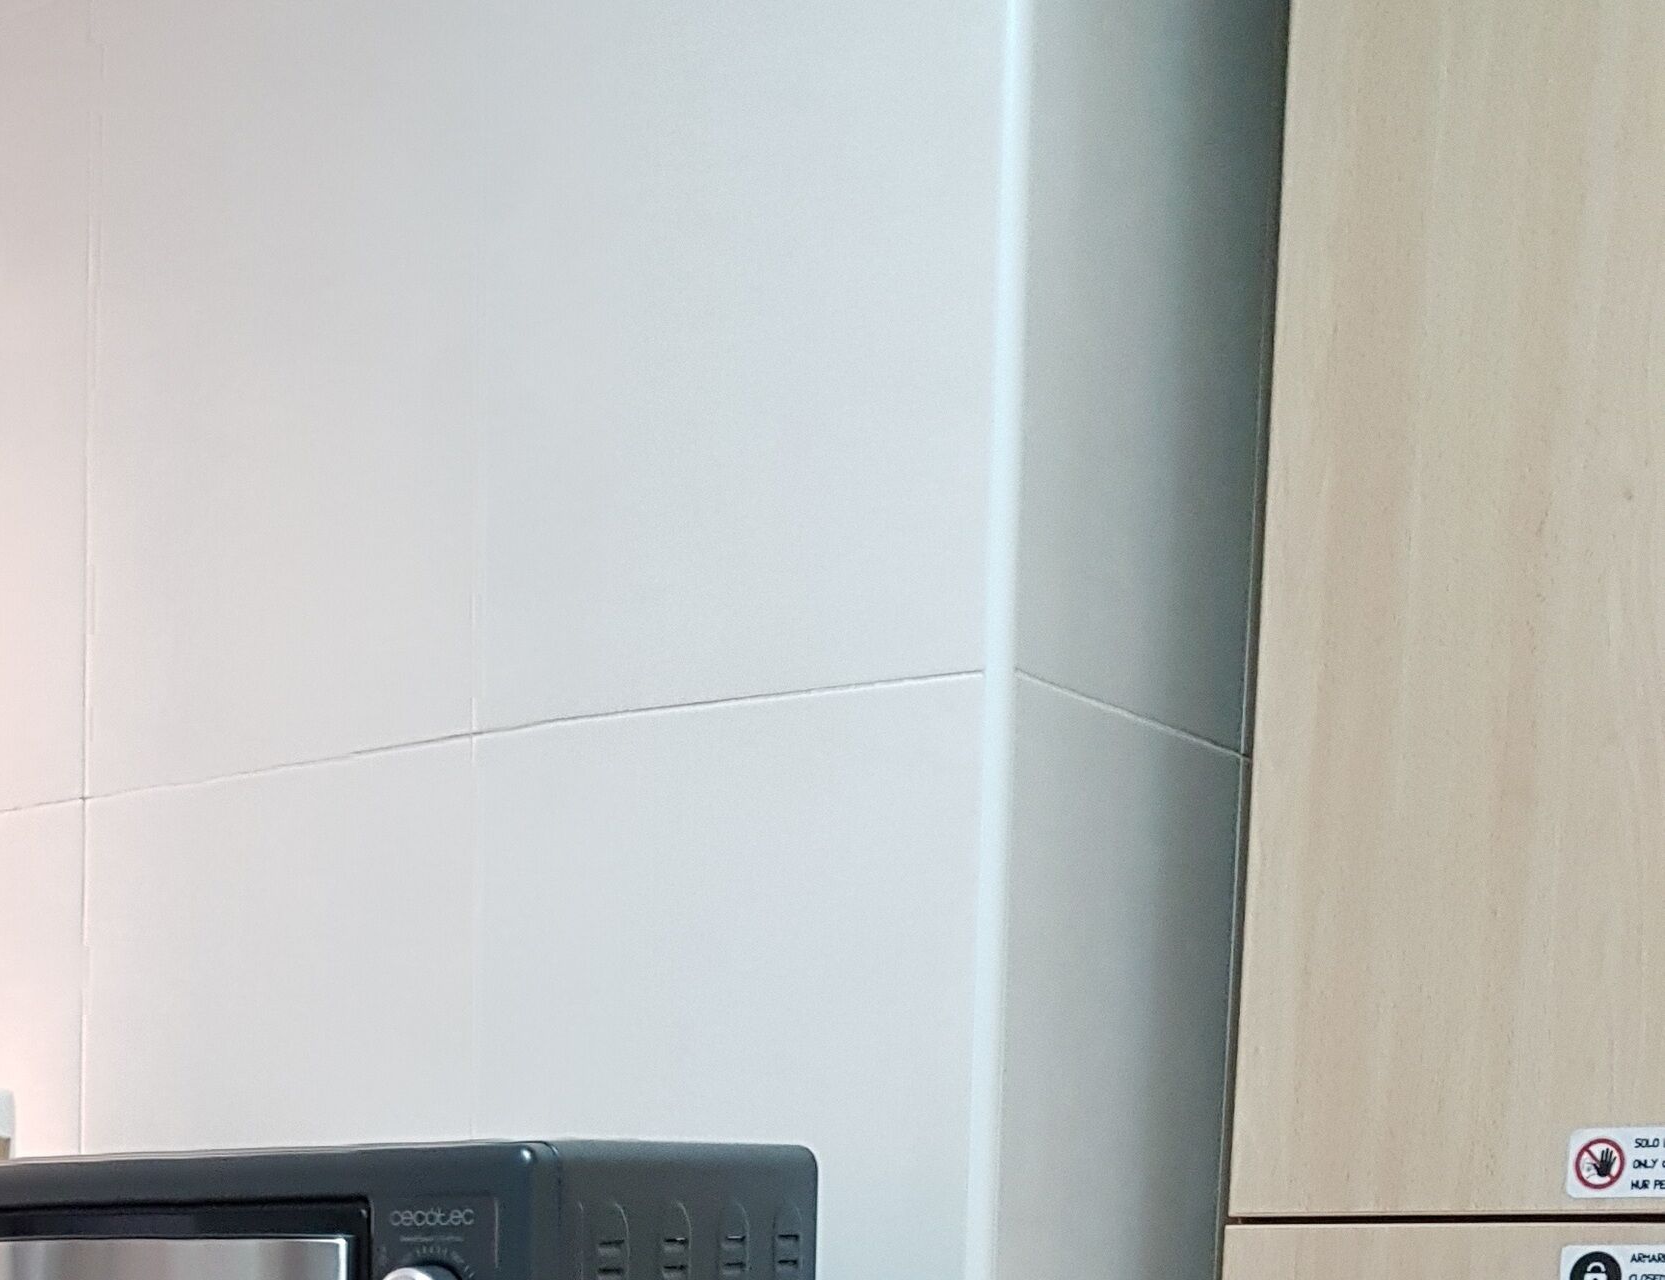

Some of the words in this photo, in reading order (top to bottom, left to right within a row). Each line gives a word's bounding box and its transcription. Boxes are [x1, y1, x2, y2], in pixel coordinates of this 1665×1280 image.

[1634, 1138, 1660, 1148] SOLO
[1633, 1159, 1659, 1169] ONLY
[1631, 1179, 1650, 1190] NUR
[390, 1207, 474, 1226] cecotec
